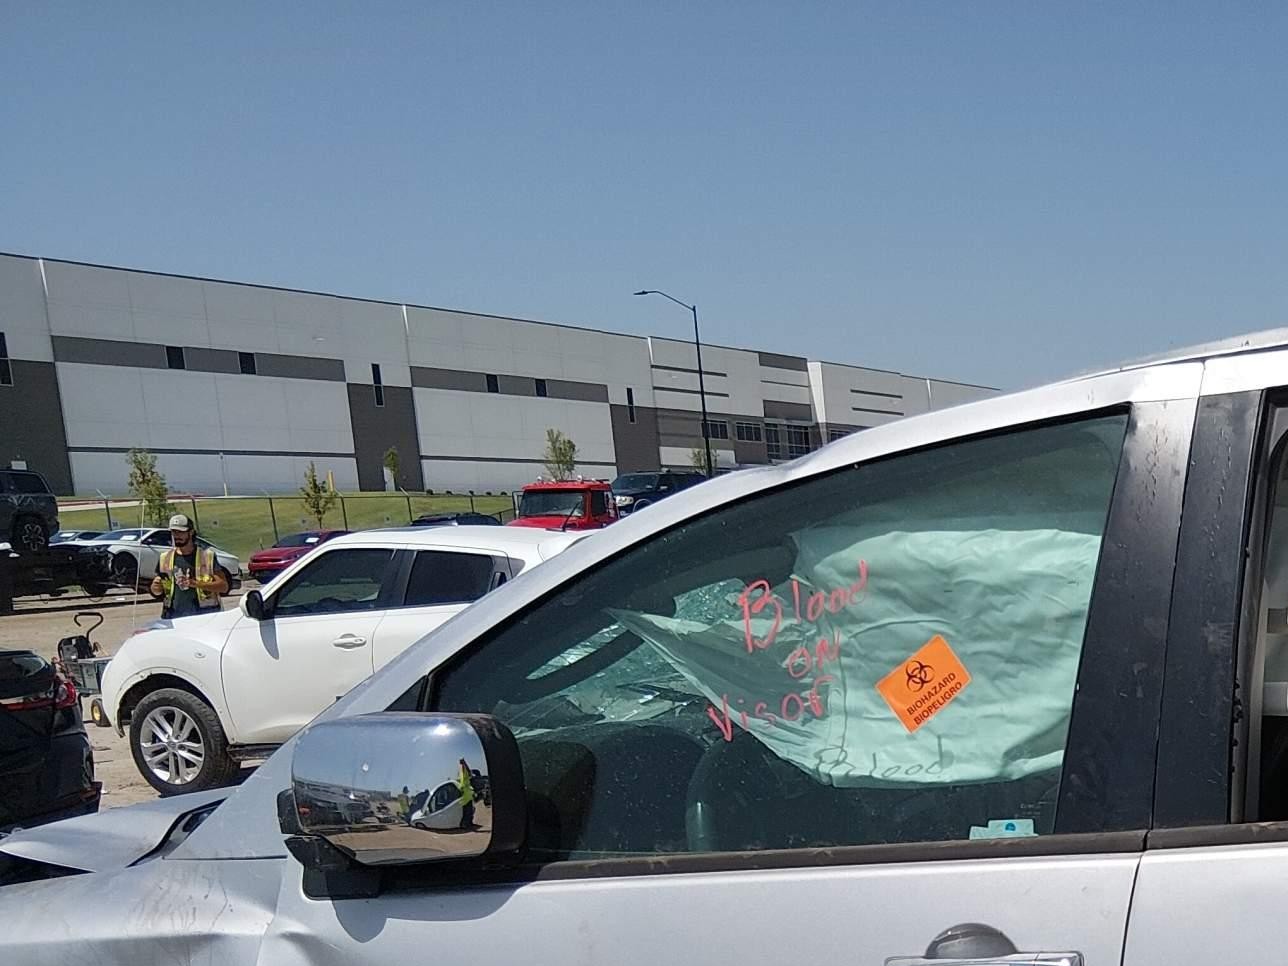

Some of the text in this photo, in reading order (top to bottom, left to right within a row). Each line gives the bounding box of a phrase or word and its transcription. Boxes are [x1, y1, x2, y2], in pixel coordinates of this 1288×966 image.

[738, 560, 868, 653] Blood
[906, 672, 956, 715] BIOHAZARD
[913, 681, 962, 725] BIOPELIGRO
